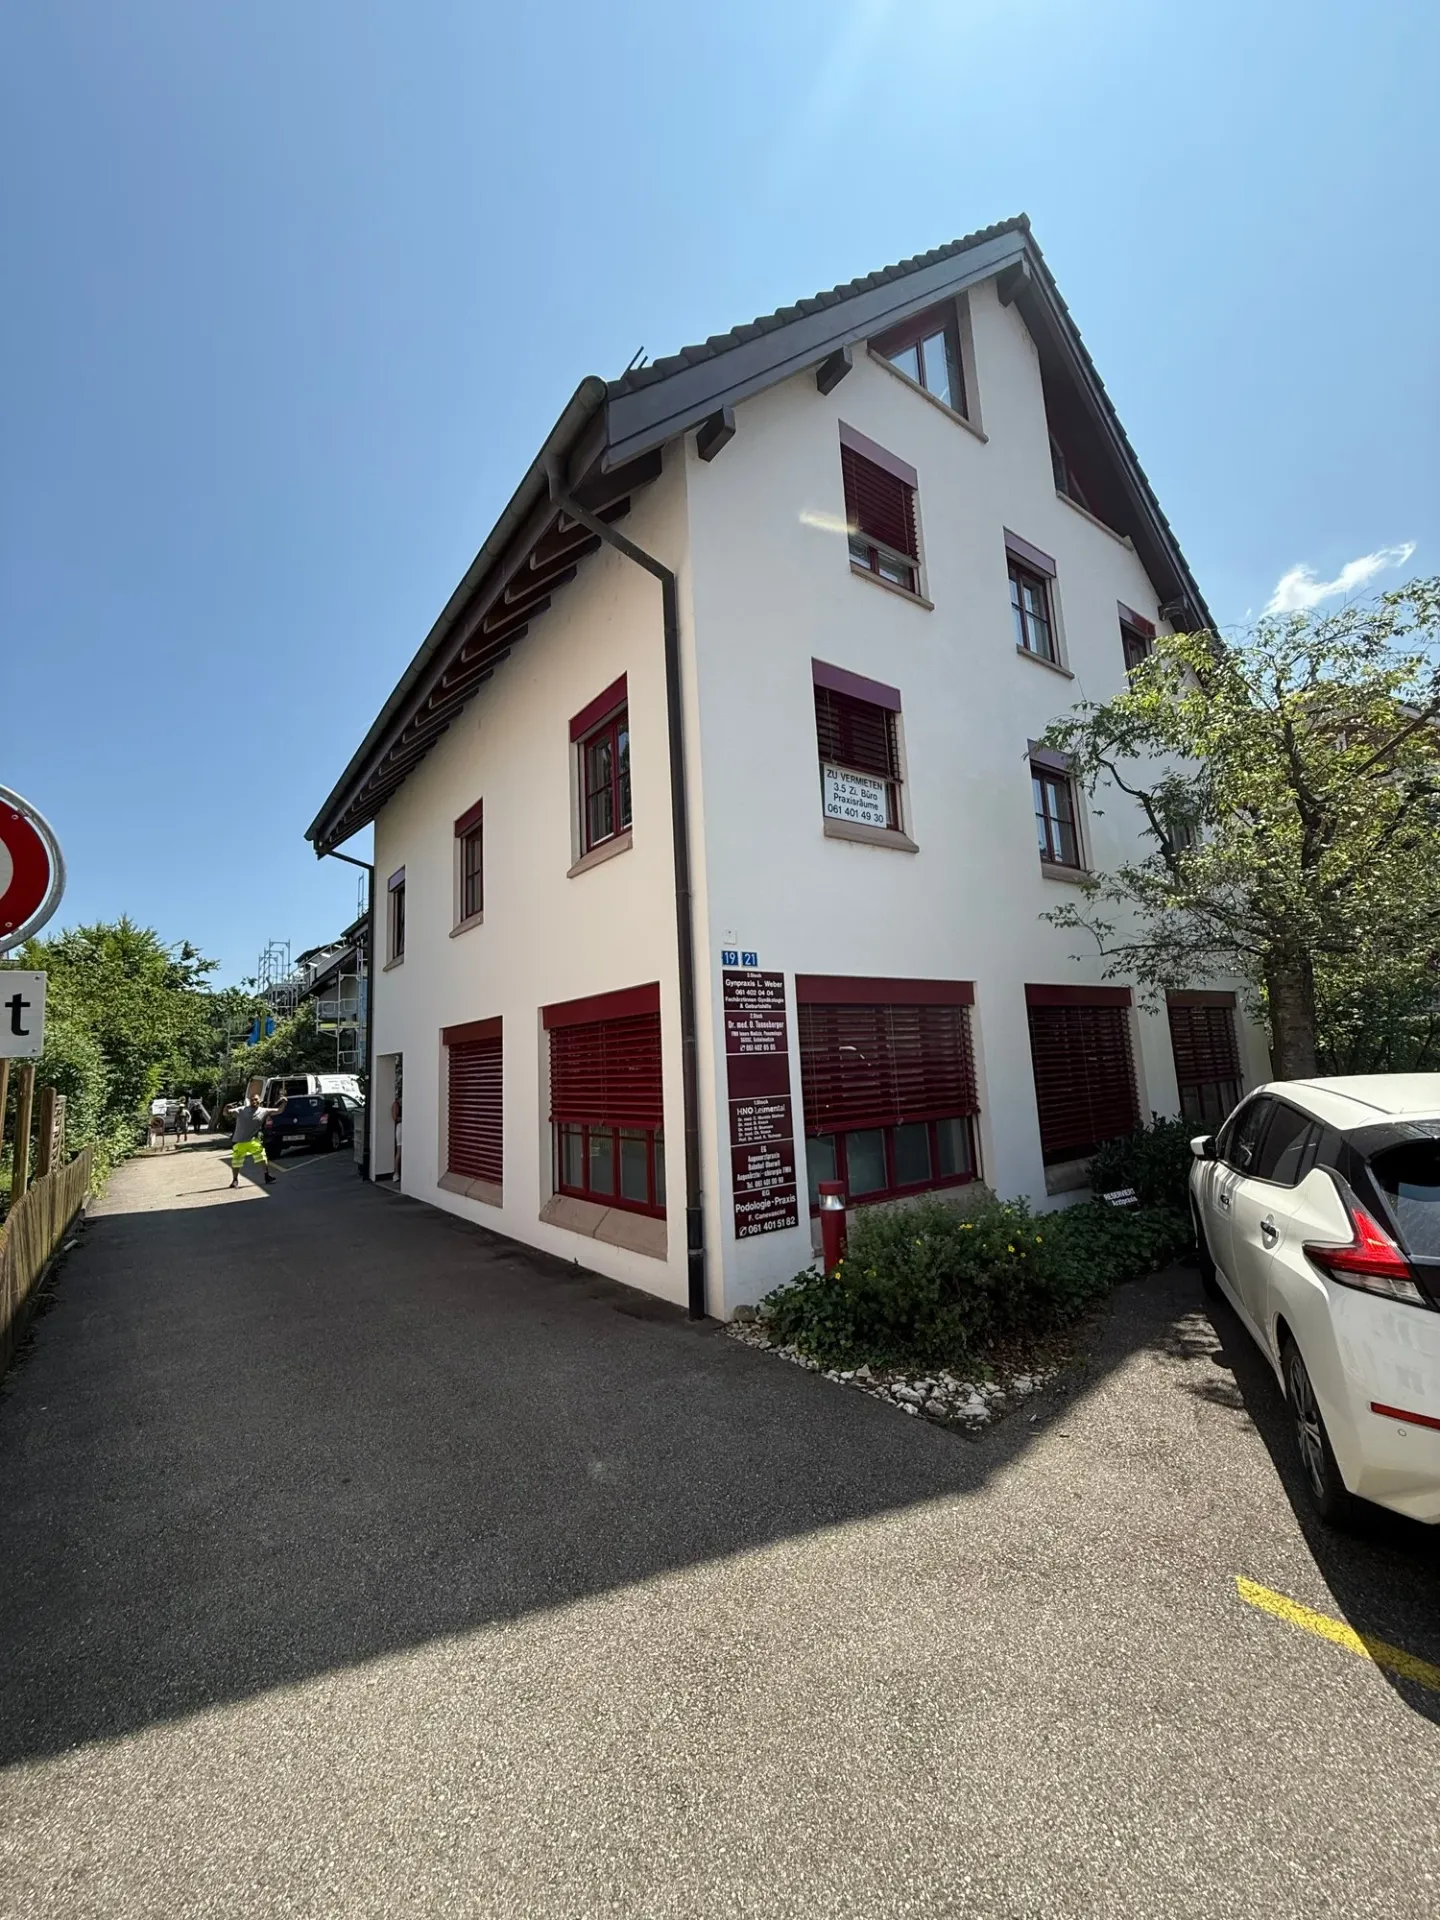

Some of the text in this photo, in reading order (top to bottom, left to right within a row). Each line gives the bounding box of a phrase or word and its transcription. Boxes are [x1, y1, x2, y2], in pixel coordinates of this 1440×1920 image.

[827, 769, 882, 790] ZU VERMIETEN
[834, 793, 878, 810] Praxisräume
[861, 789, 877, 800] Büro
[828, 804, 883, 823] 061 401 49 30
[725, 952, 735, 964] 19
[745, 954, 755, 965] 21
[737, 1104, 785, 1115] HNO Leimental
[748, 1224, 761, 1234] 061
[764, 1221, 776, 1230] 401
[786, 1216, 795, 1225] 82
